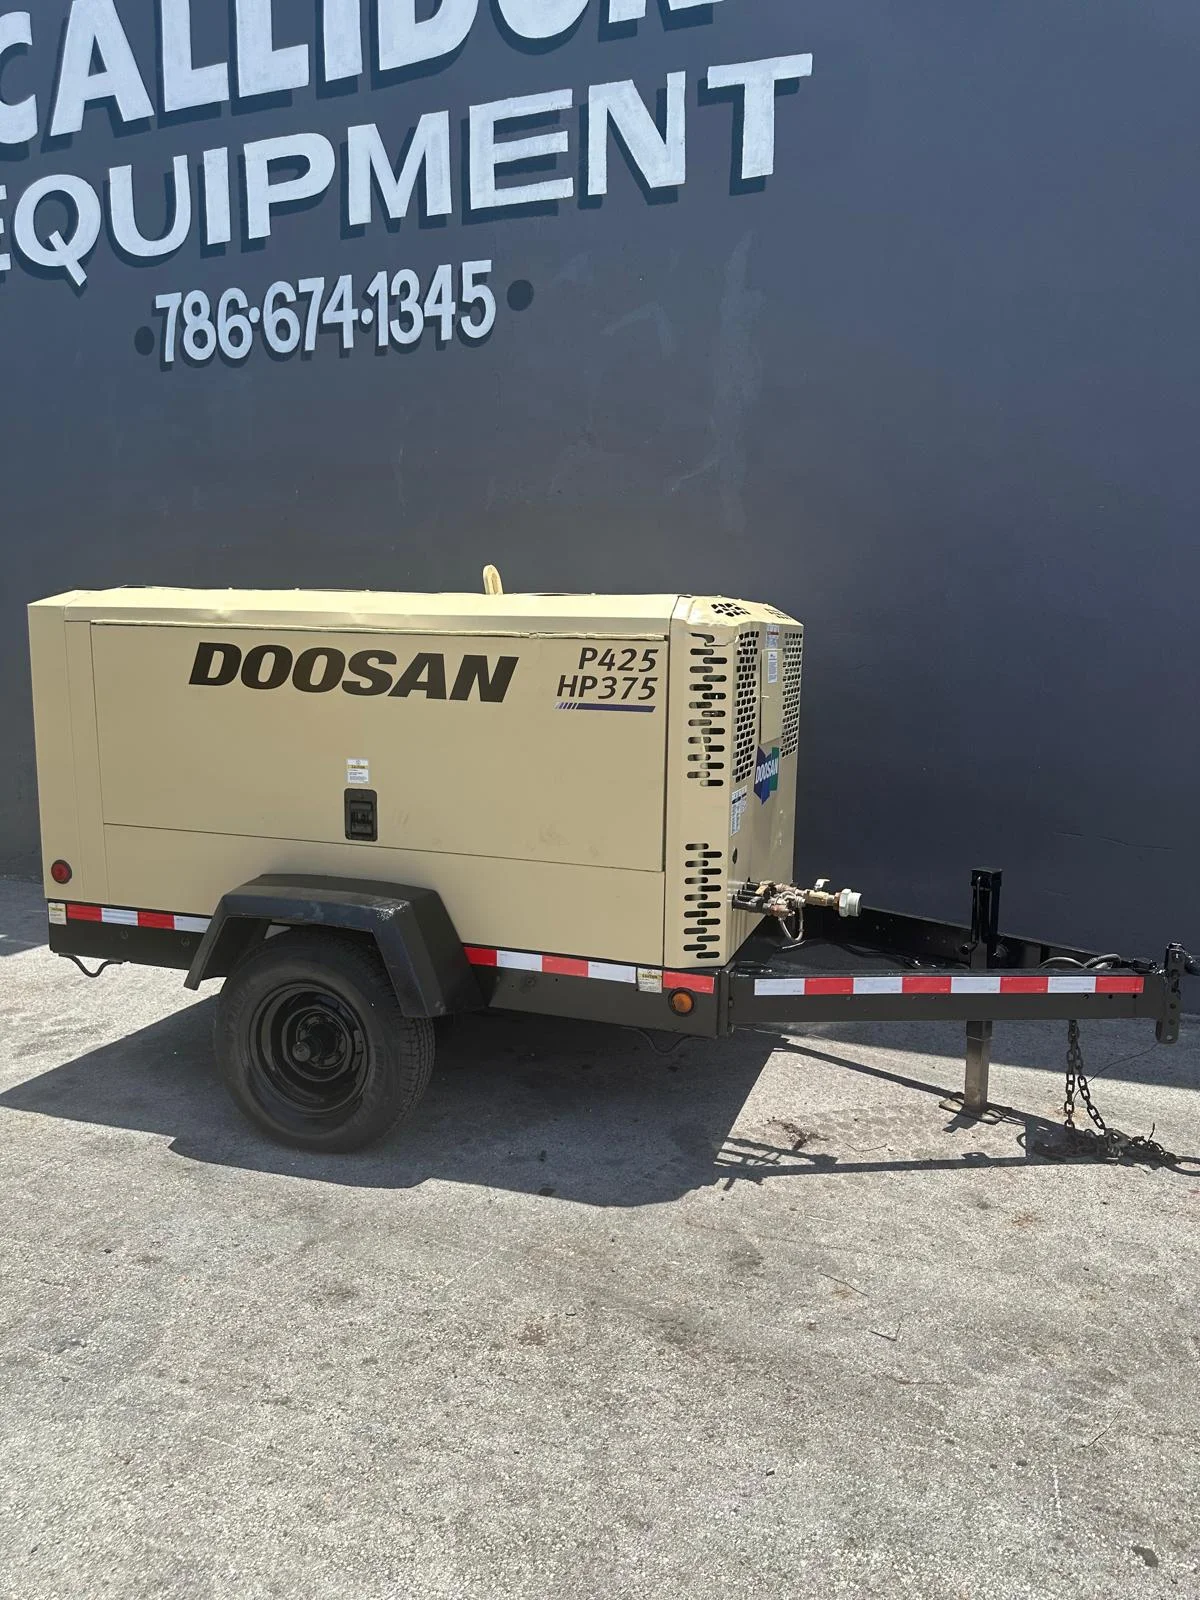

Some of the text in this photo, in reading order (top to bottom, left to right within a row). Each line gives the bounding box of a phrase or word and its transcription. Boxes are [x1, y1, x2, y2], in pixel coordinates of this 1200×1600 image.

[0, 53, 813, 287] QUIPMENT
[188, 641, 519, 703] DOOSAN
[579, 647, 659, 672] P425
[557, 675, 658, 700] HP375
[755, 757, 779, 784] DOOSAN
